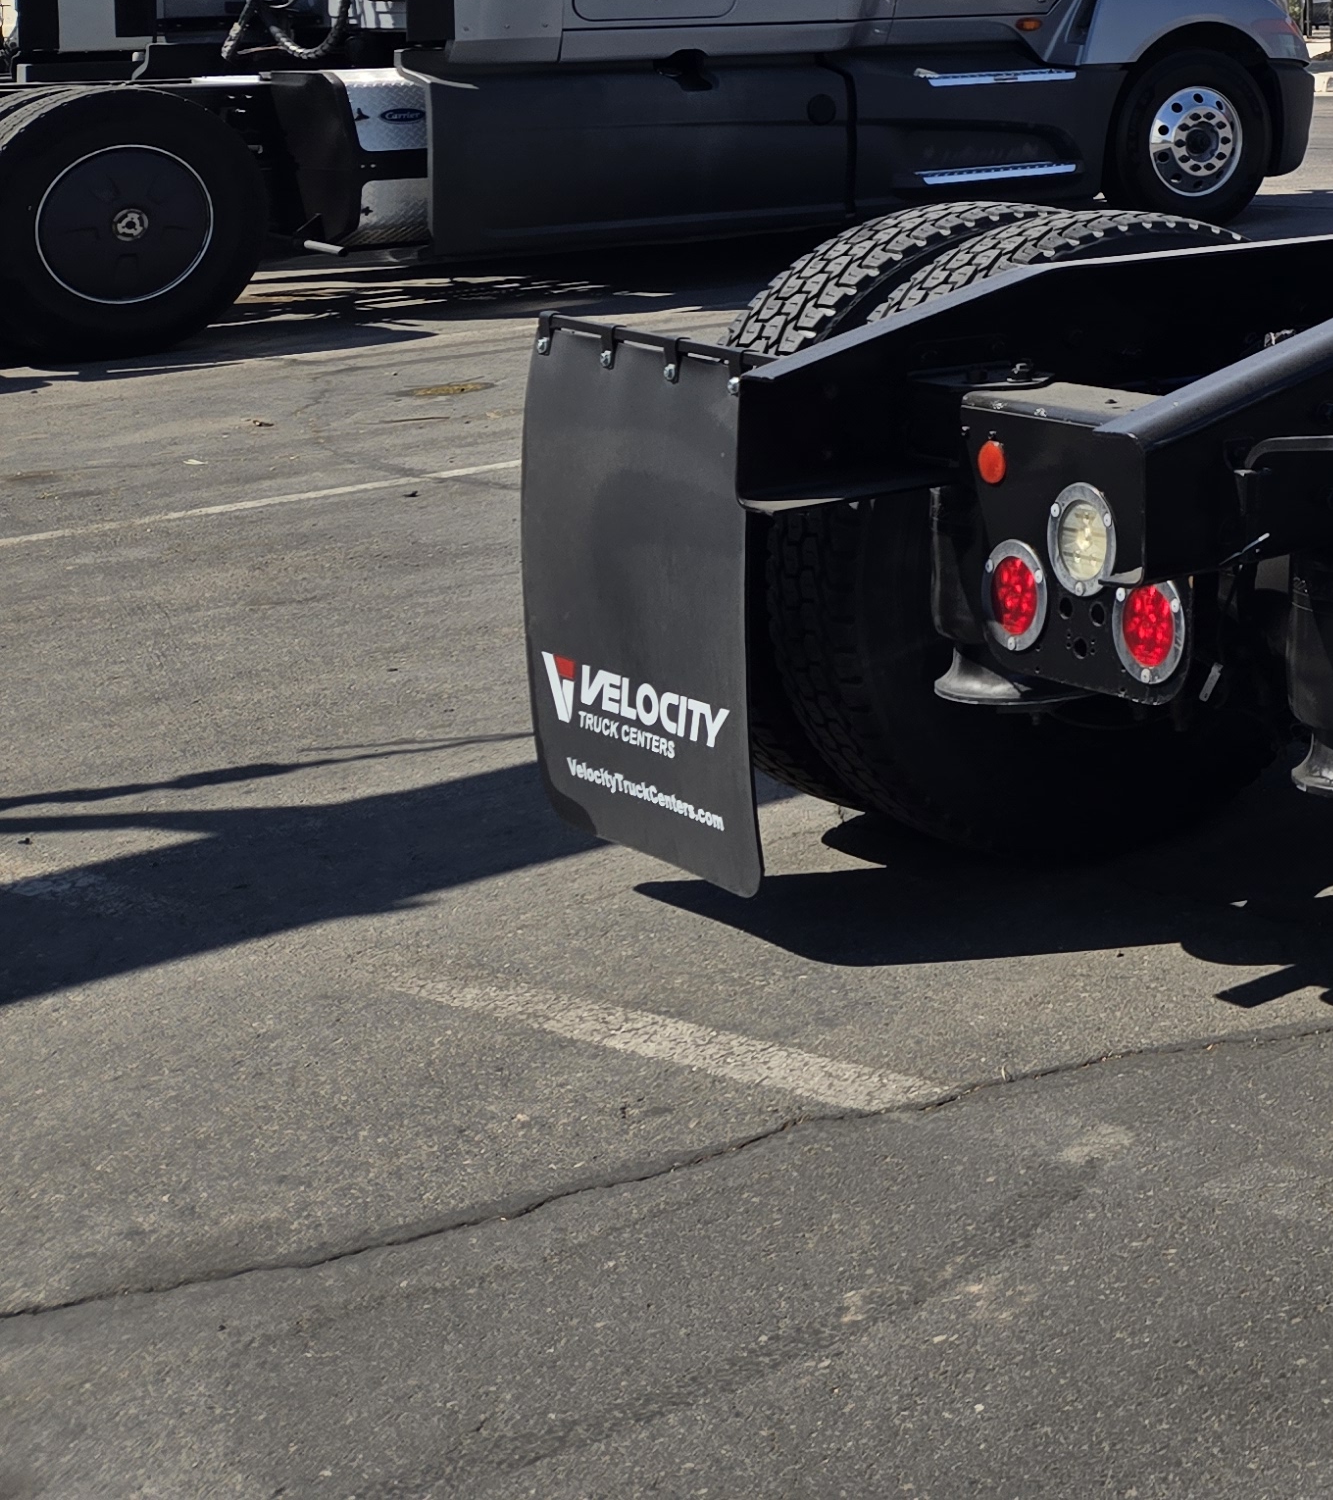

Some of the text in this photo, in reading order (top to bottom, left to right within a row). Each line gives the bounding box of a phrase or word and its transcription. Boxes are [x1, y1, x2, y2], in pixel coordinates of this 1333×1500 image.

[385, 111, 421, 120] Carrier
[578, 711, 676, 759] TRUCK CENTERS
[580, 664, 730, 748] VELOCITY
[566, 757, 725, 831] VelocityTruckCenters.com
